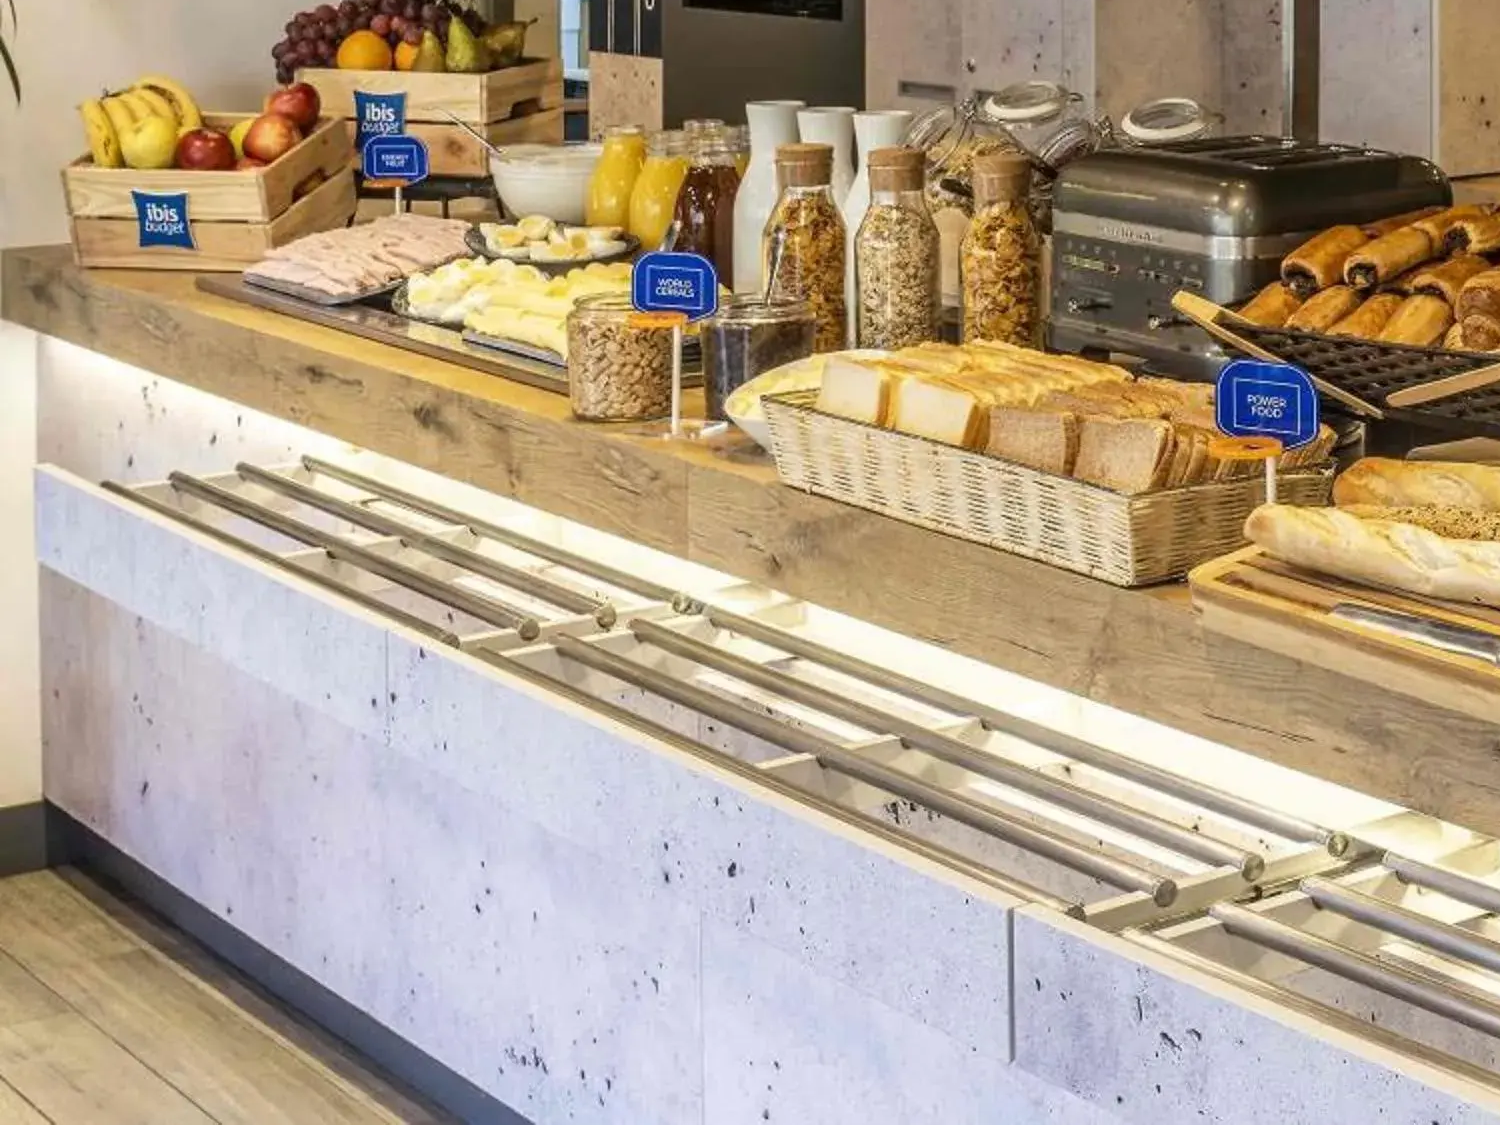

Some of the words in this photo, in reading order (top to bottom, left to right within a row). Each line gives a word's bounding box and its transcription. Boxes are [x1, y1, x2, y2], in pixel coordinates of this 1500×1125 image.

[364, 102, 396, 122] ibis
[145, 202, 179, 222] ibis
[145, 218, 186, 236] budget
[657, 277, 693, 287] WORLD
[655, 286, 695, 298] CEREALS
[1247, 393, 1287, 408] POWER
[1250, 405, 1283, 419] FOOD
